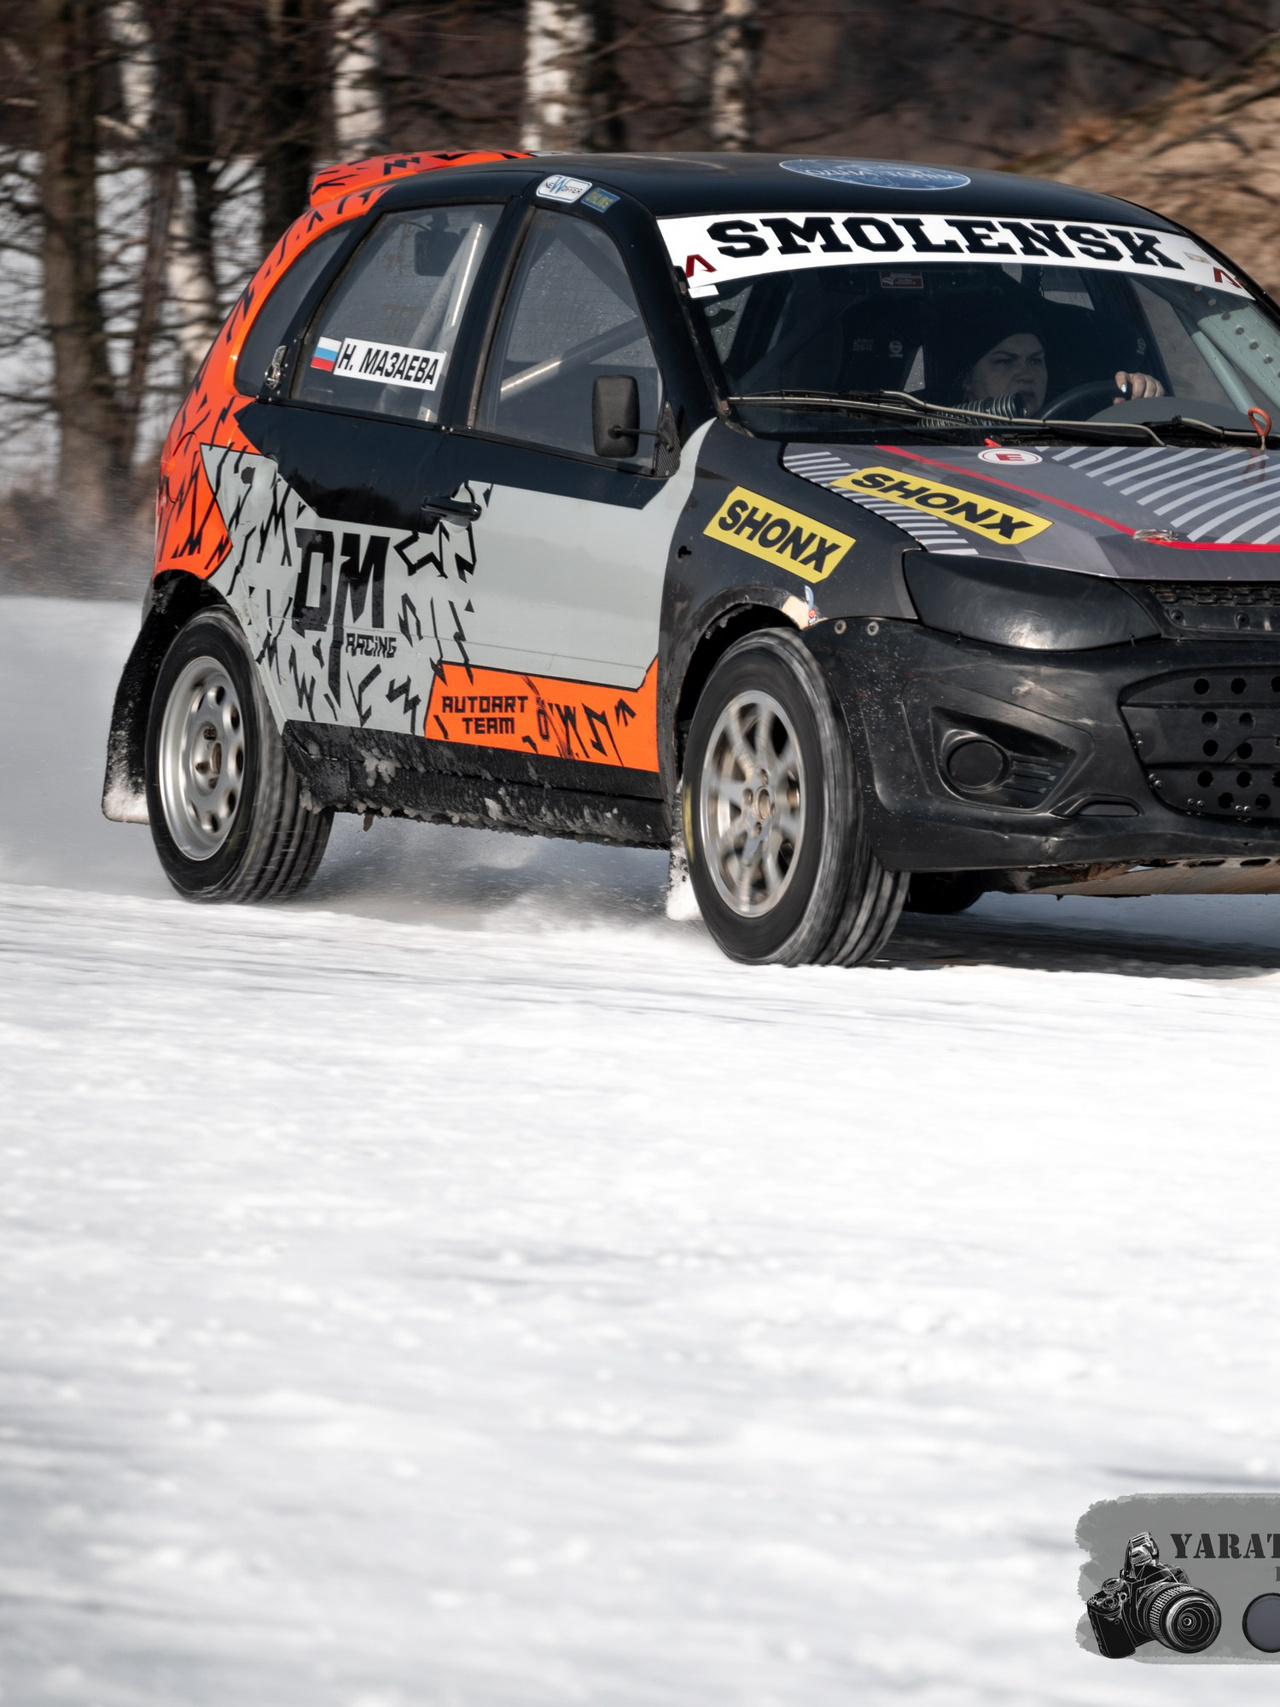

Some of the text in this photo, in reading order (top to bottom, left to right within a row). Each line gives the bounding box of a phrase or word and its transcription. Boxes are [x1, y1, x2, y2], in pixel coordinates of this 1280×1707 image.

[707, 216, 1180, 270] SMOLENSK
[337, 343, 440, 385] Н. МАЗАЕВА
[851, 473, 1035, 539] SHONX
[718, 499, 843, 572] SHONX
[441, 695, 528, 714] AUTOART
[462, 717, 515, 735] TEAM
